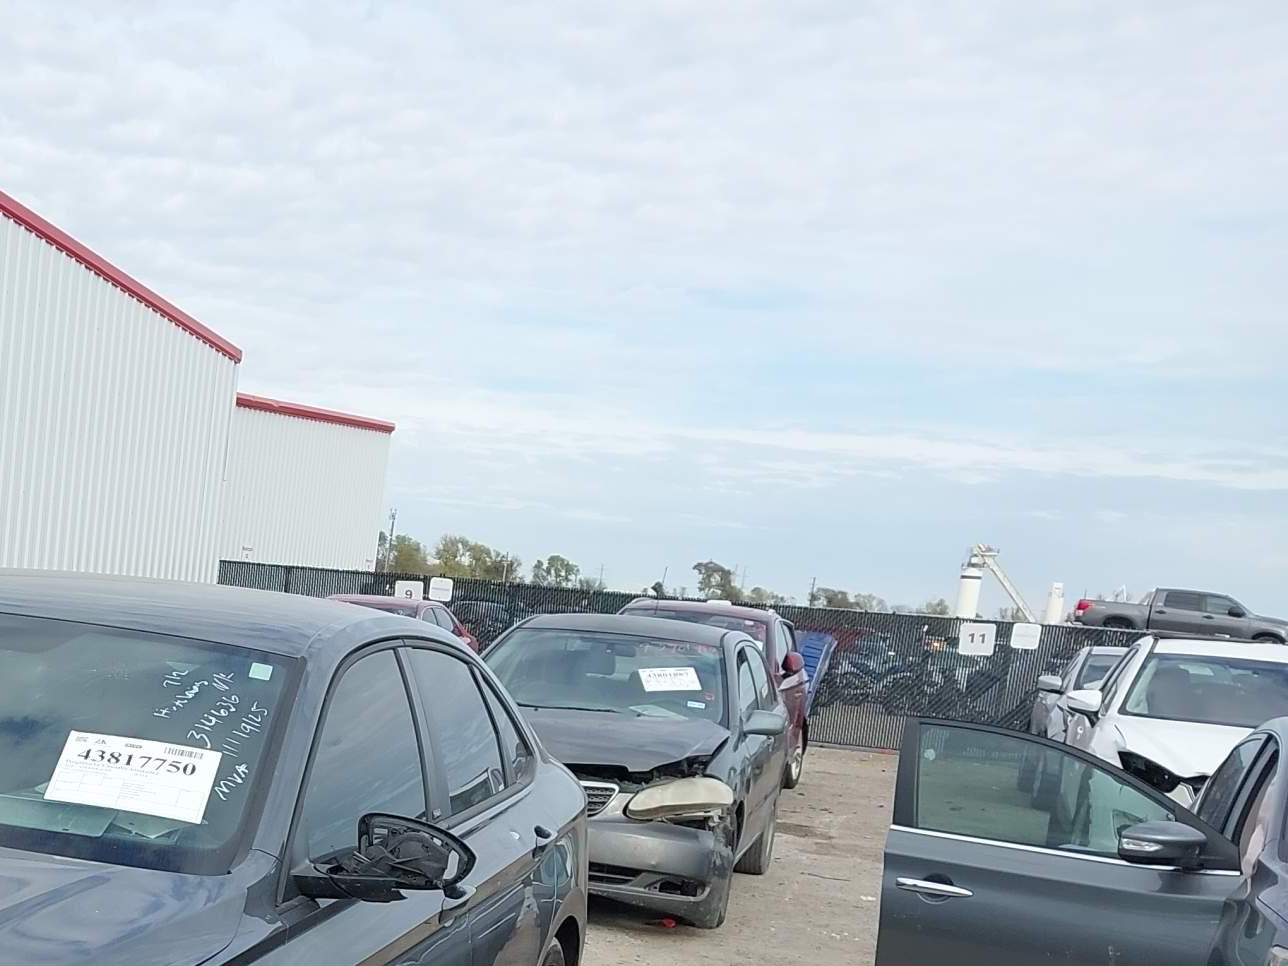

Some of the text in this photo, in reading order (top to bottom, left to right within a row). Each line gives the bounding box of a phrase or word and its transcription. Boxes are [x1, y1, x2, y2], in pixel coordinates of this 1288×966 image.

[404, 589, 413, 600] 9
[968, 632, 987, 644] 11
[76, 747, 198, 777] 43817750
